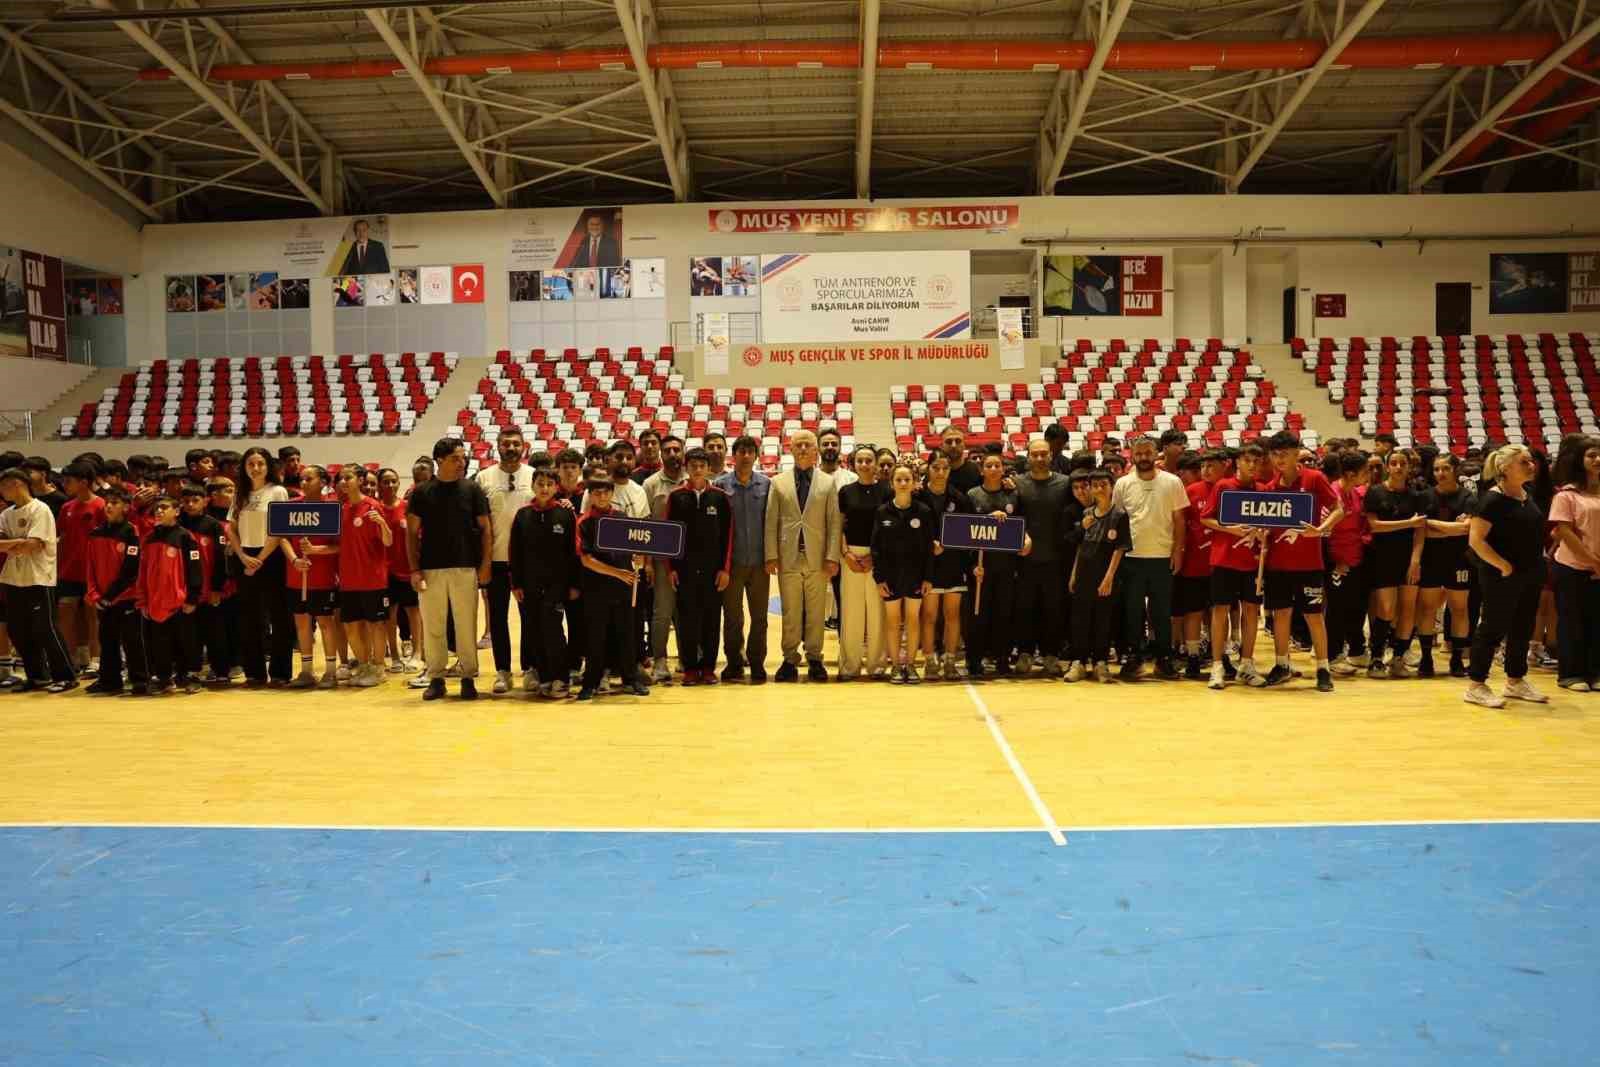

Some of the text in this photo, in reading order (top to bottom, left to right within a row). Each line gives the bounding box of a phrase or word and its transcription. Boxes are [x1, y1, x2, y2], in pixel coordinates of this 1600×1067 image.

[741, 212, 791, 230] MUŞ
[796, 210, 846, 227] YENİ
[913, 209, 1008, 226] SALONU
[813, 276, 917, 289] TÜM ANTRENÖR VE
[816, 287, 914, 300] SPORCULARIMIZA
[811, 302, 865, 312] BAŞARILAR
[769, 344, 990, 366] MUŞ GENÇLİK VE SPOR İL MÜDÜRLÜĞÜ
[1241, 499, 1292, 517] ELAZIĞ
[289, 511, 320, 526] KARS
[628, 528, 652, 544] MUŞ
[970, 525, 998, 540] VAN
